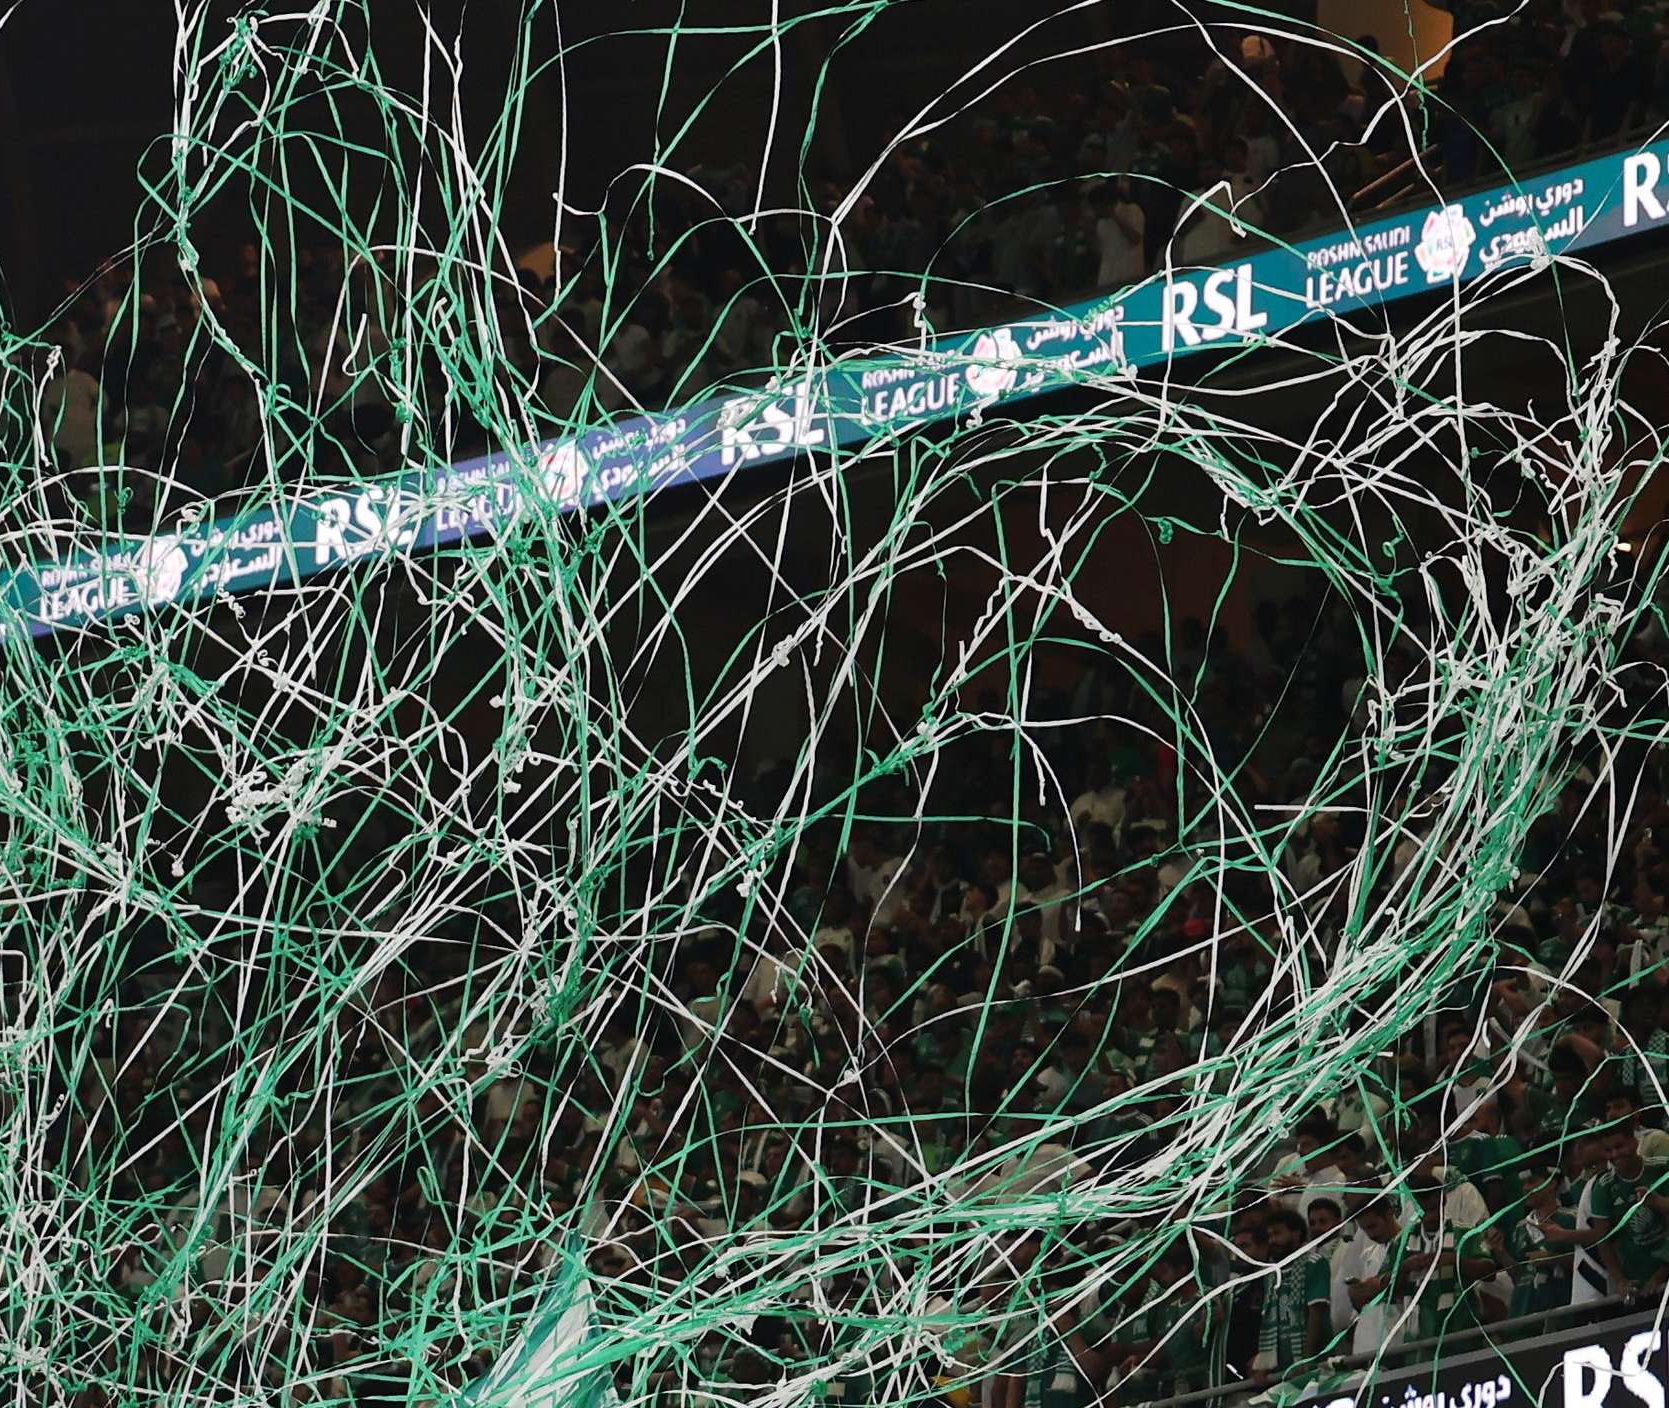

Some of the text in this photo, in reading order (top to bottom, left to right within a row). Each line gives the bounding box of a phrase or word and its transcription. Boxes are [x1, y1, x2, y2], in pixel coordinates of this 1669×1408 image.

[1479, 178, 1584, 228] دوري روشن
[1307, 225, 1412, 271] ROSHN SAUDI
[1305, 251, 1409, 309] LEAGUE
[1162, 263, 1268, 353] RSL
[721, 381, 825, 465] RSL
[861, 373, 960, 425] LEAGUE
